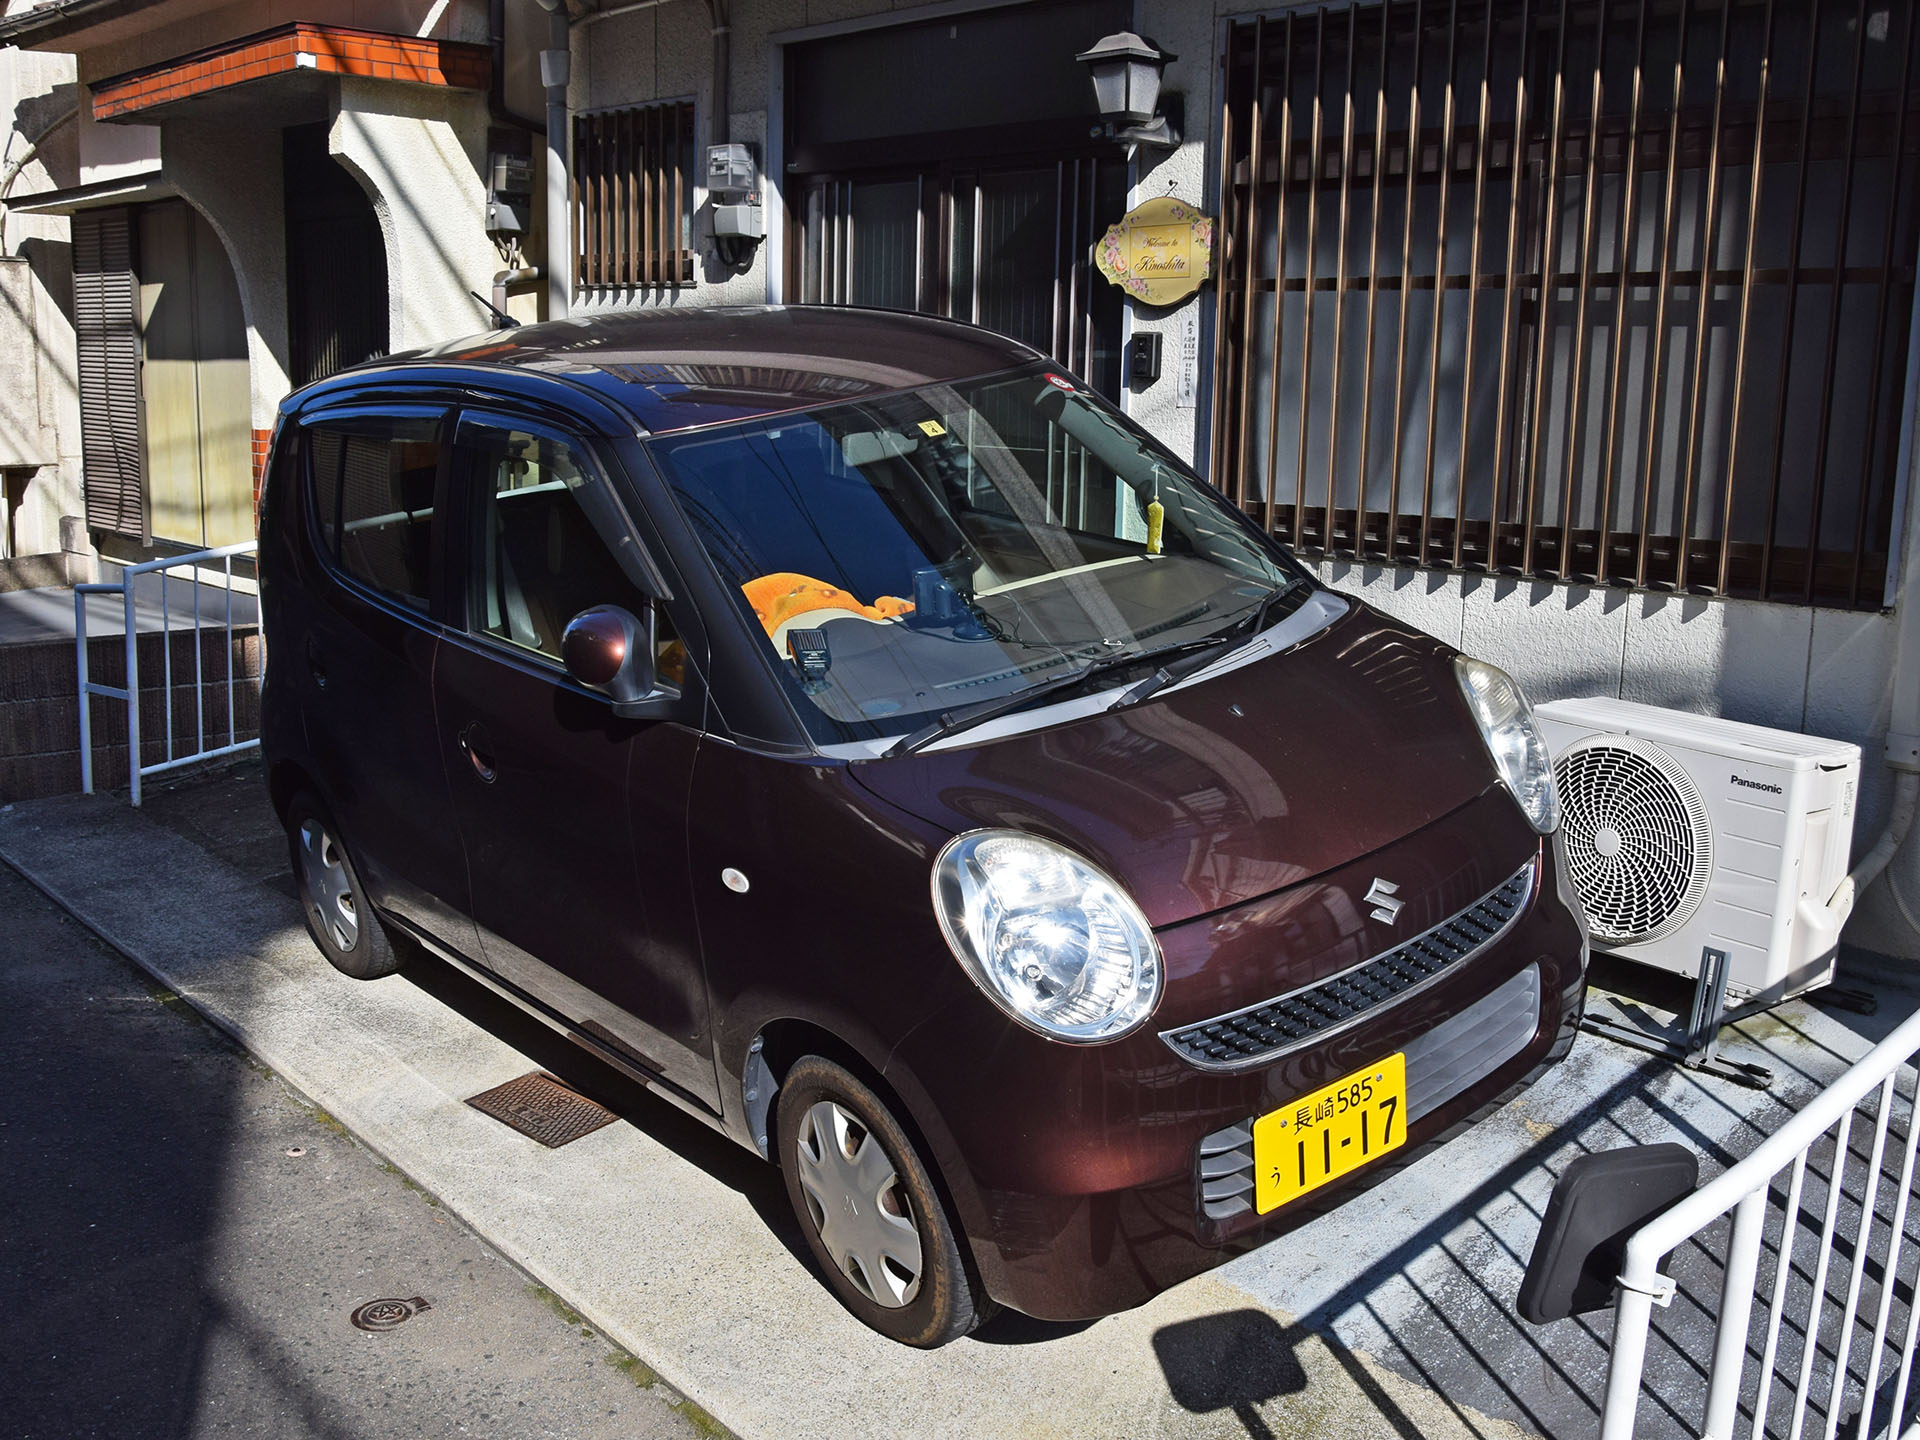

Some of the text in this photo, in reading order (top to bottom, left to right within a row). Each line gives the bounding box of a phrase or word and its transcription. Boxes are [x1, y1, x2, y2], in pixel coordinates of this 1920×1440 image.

[1143, 237, 1178, 248] Welcome to
[1135, 254, 1185, 272] Kinoshita
[1730, 775, 1783, 795] Panasonic
[1297, 1096, 1398, 1187] 11-17
